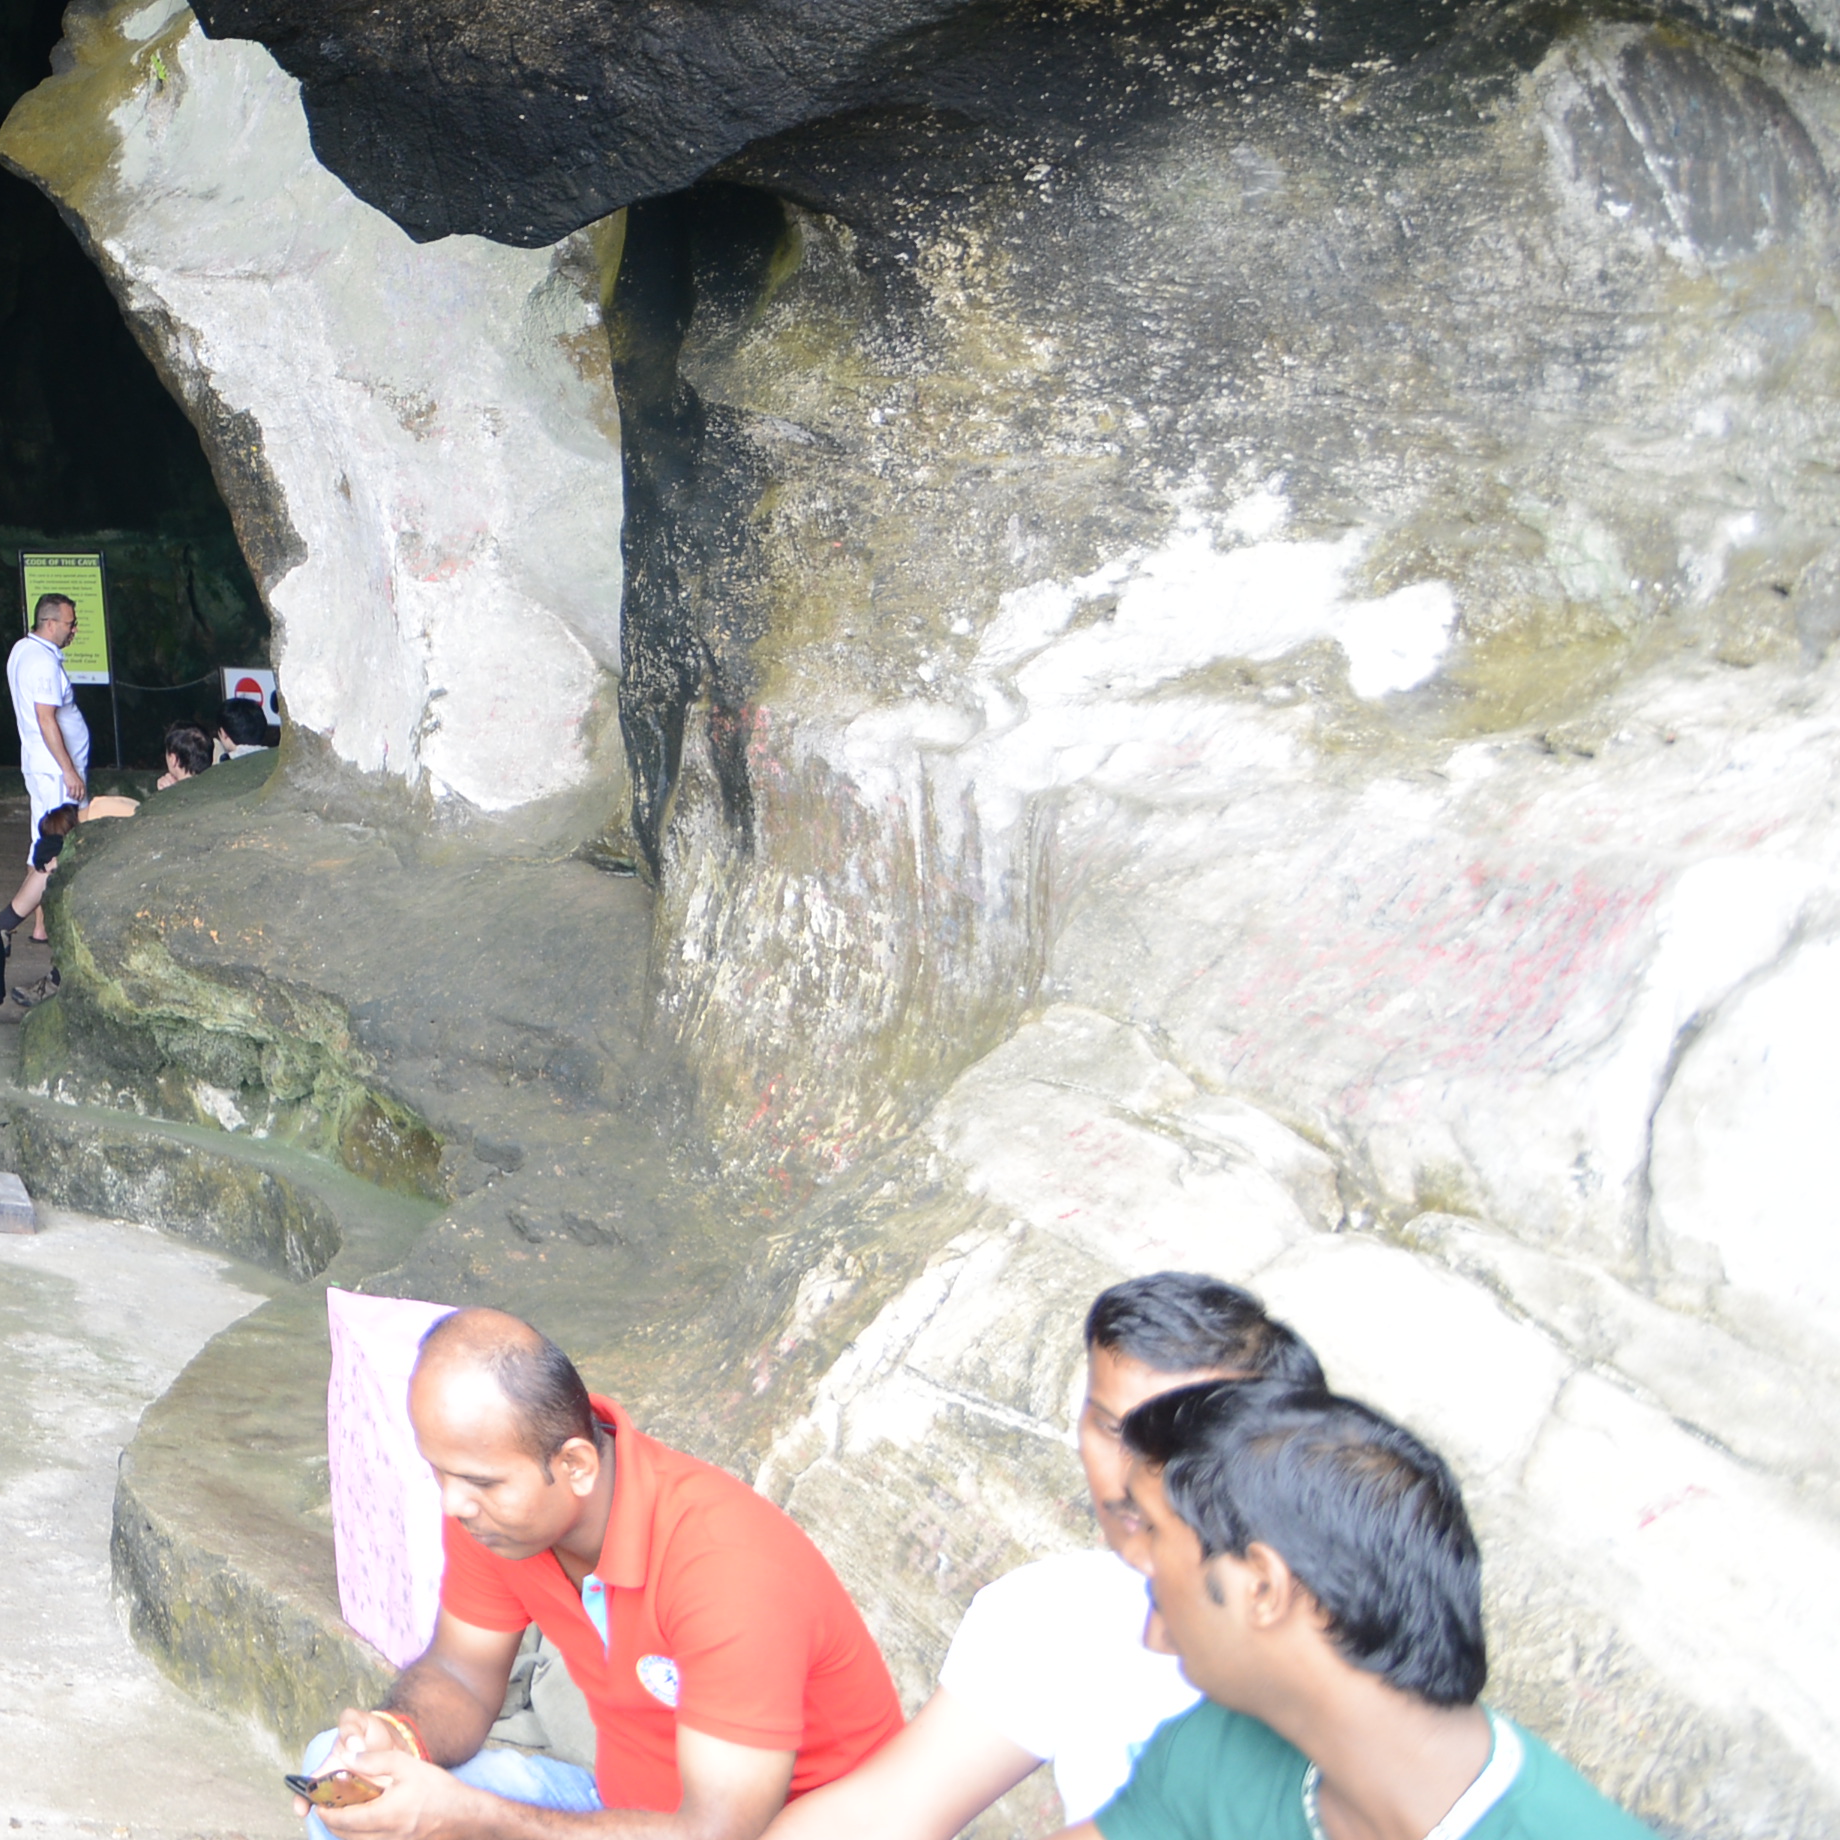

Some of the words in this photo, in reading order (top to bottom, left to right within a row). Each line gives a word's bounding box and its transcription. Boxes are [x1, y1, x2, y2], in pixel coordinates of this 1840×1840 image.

[25, 558, 47, 567] CODE
[48, 558, 59, 567] OF
[61, 558, 76, 567] THE
[77, 558, 98, 567] CAVE
